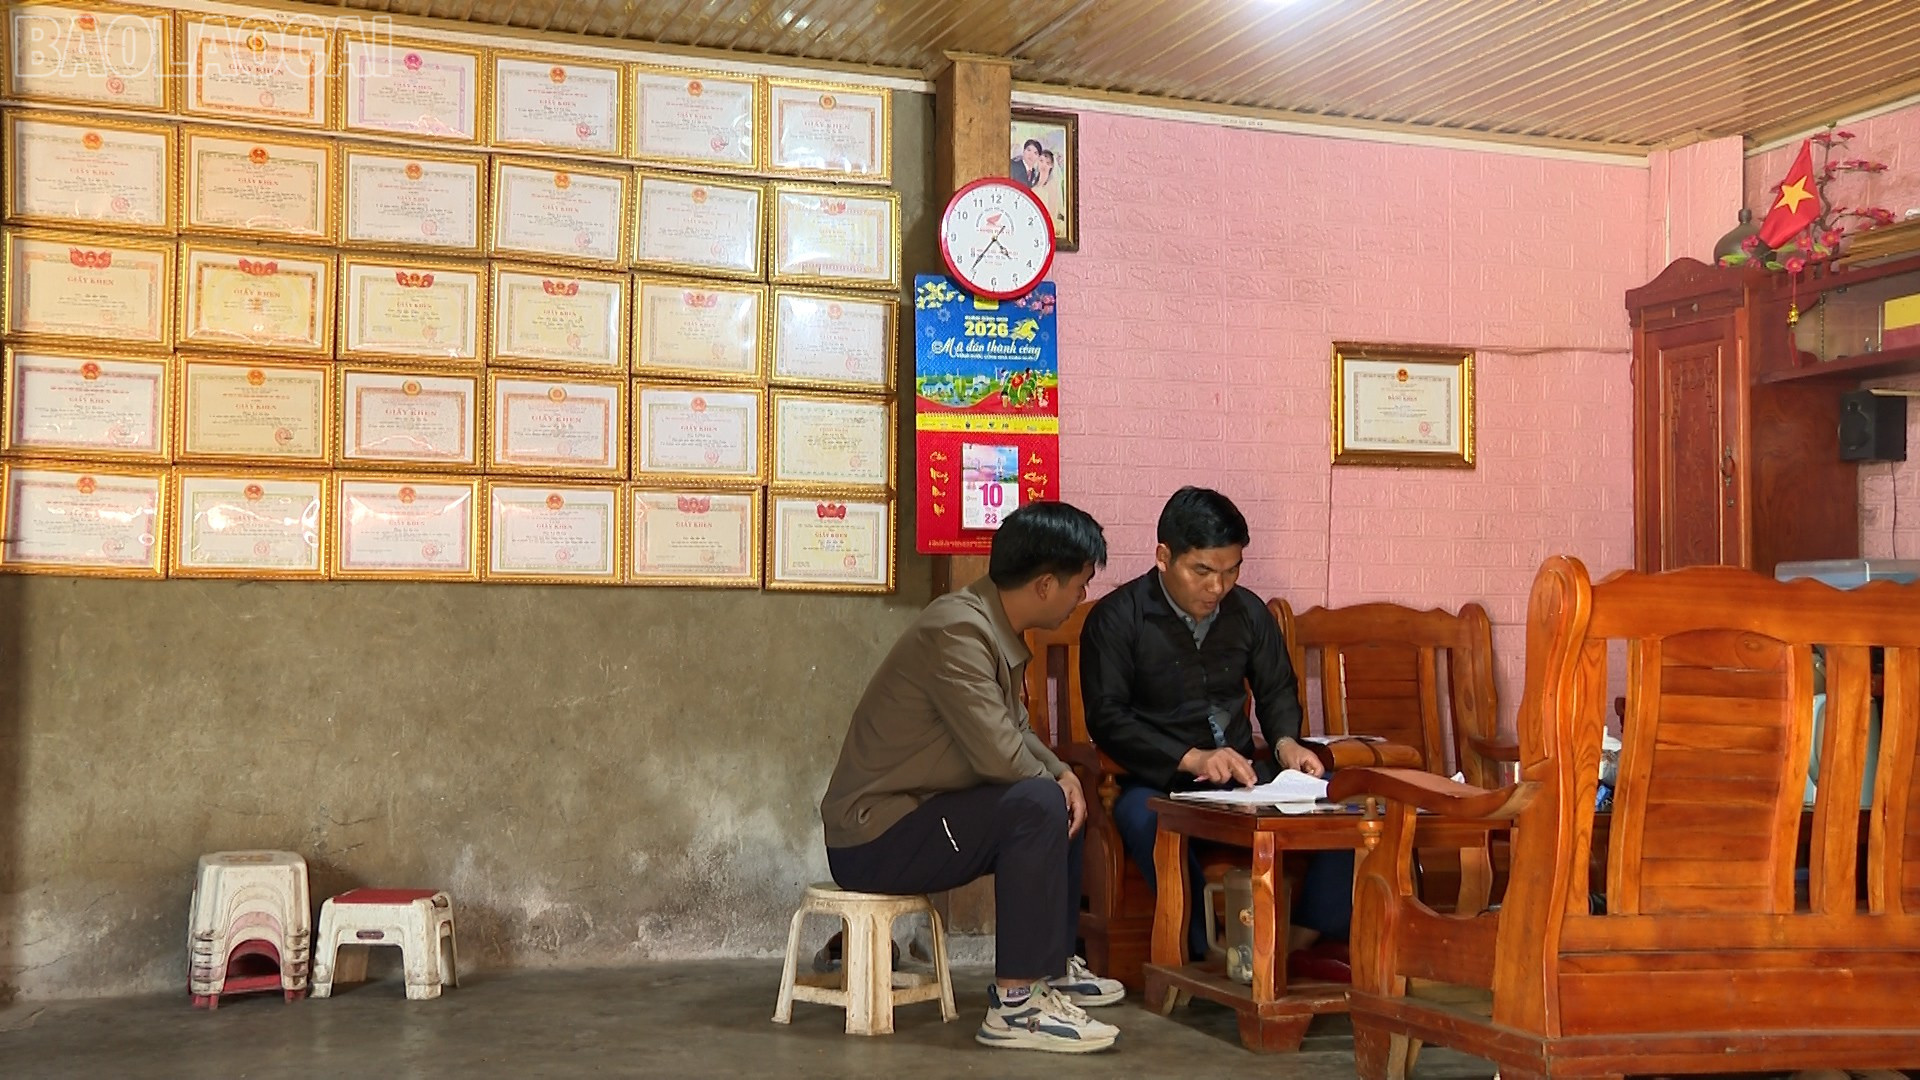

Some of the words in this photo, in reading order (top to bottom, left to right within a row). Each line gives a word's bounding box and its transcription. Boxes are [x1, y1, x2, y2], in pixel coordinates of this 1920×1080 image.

[973, 199, 983, 207] 11
[991, 195, 1002, 204] 12
[1014, 201, 1018, 209] 1
[957, 211, 968, 220] 10
[1028, 217, 1034, 226] 2
[951, 233, 957, 241] 9
[1034, 239, 1039, 248] 3
[957, 255, 962, 263] 8
[1026, 259, 1032, 268] 4
[991, 277, 997, 286] 6
[1012, 273, 1018, 282] 5
[964, 321, 1009, 337] 2026
[979, 483, 1003, 507] 10
[985, 513, 997, 524] 23
